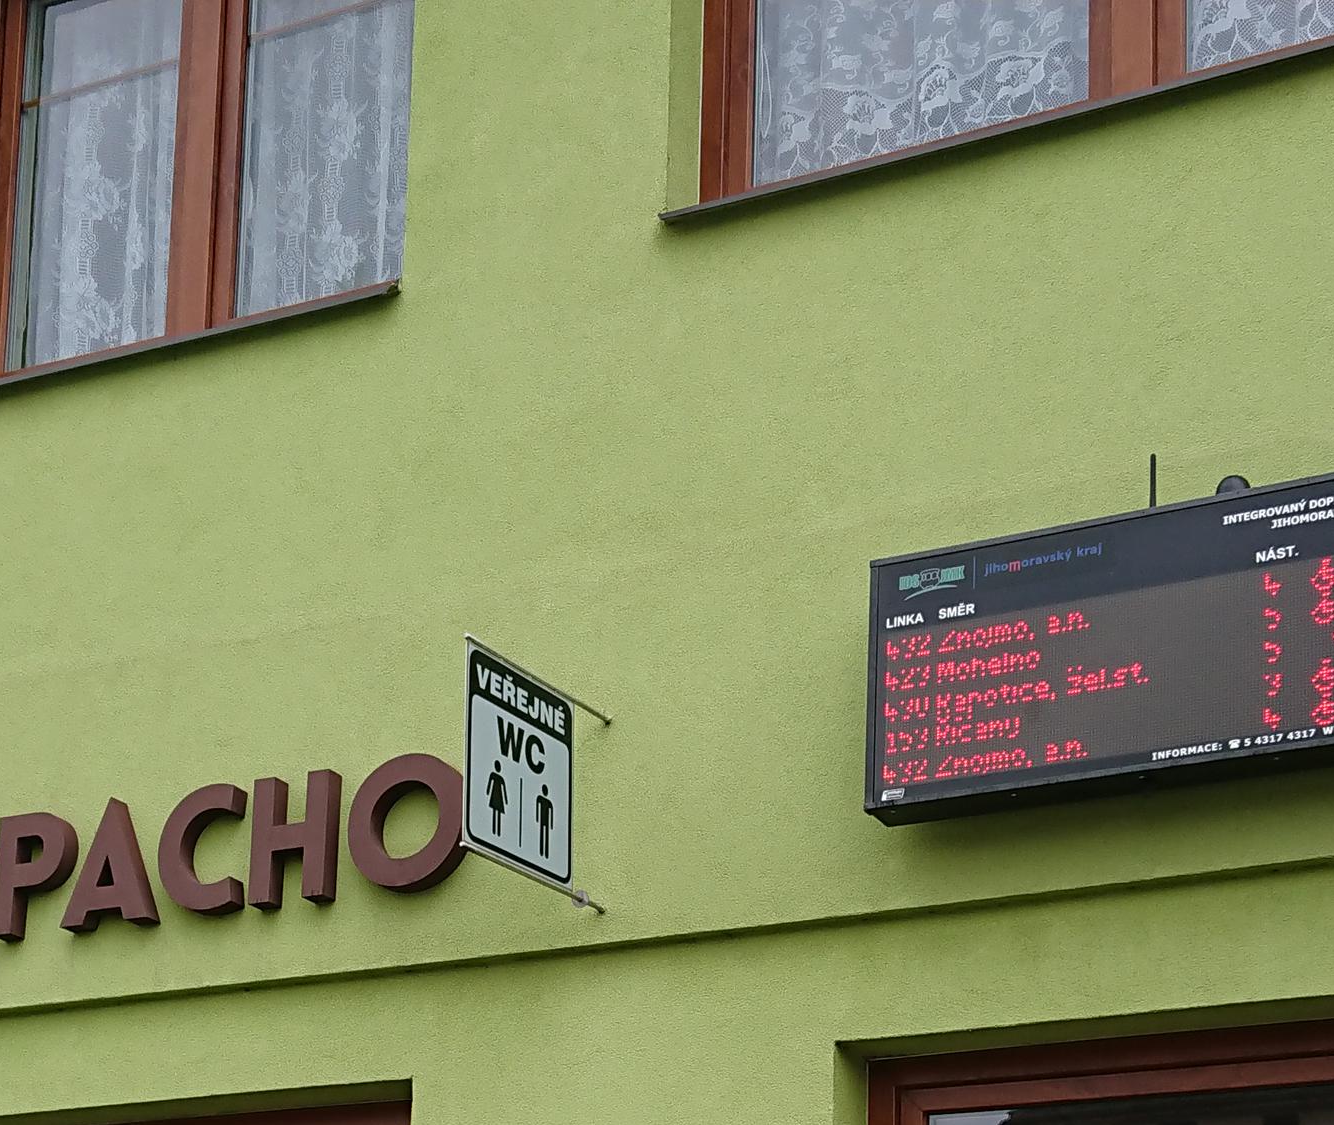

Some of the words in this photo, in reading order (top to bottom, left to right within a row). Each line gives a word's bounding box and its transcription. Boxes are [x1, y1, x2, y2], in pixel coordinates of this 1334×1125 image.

[1222, 498, 1306, 526] INTEGROVANÝ
[984, 549, 1071, 577] jihomoravský
[1076, 542, 1102, 558] kraj
[1255, 545, 1299, 563] NÁST.
[886, 612, 924, 629] LINKA
[938, 603, 975, 620] SMĚR
[476, 663, 566, 736] VEŘEJNÉ
[496, 715, 546, 775] WC
[1151, 742, 1223, 761] INFORMACE:
[1244, 737, 1251, 747] 5
[1254, 733, 1283, 746] 4317
[1287, 729, 1316, 741] 4317
